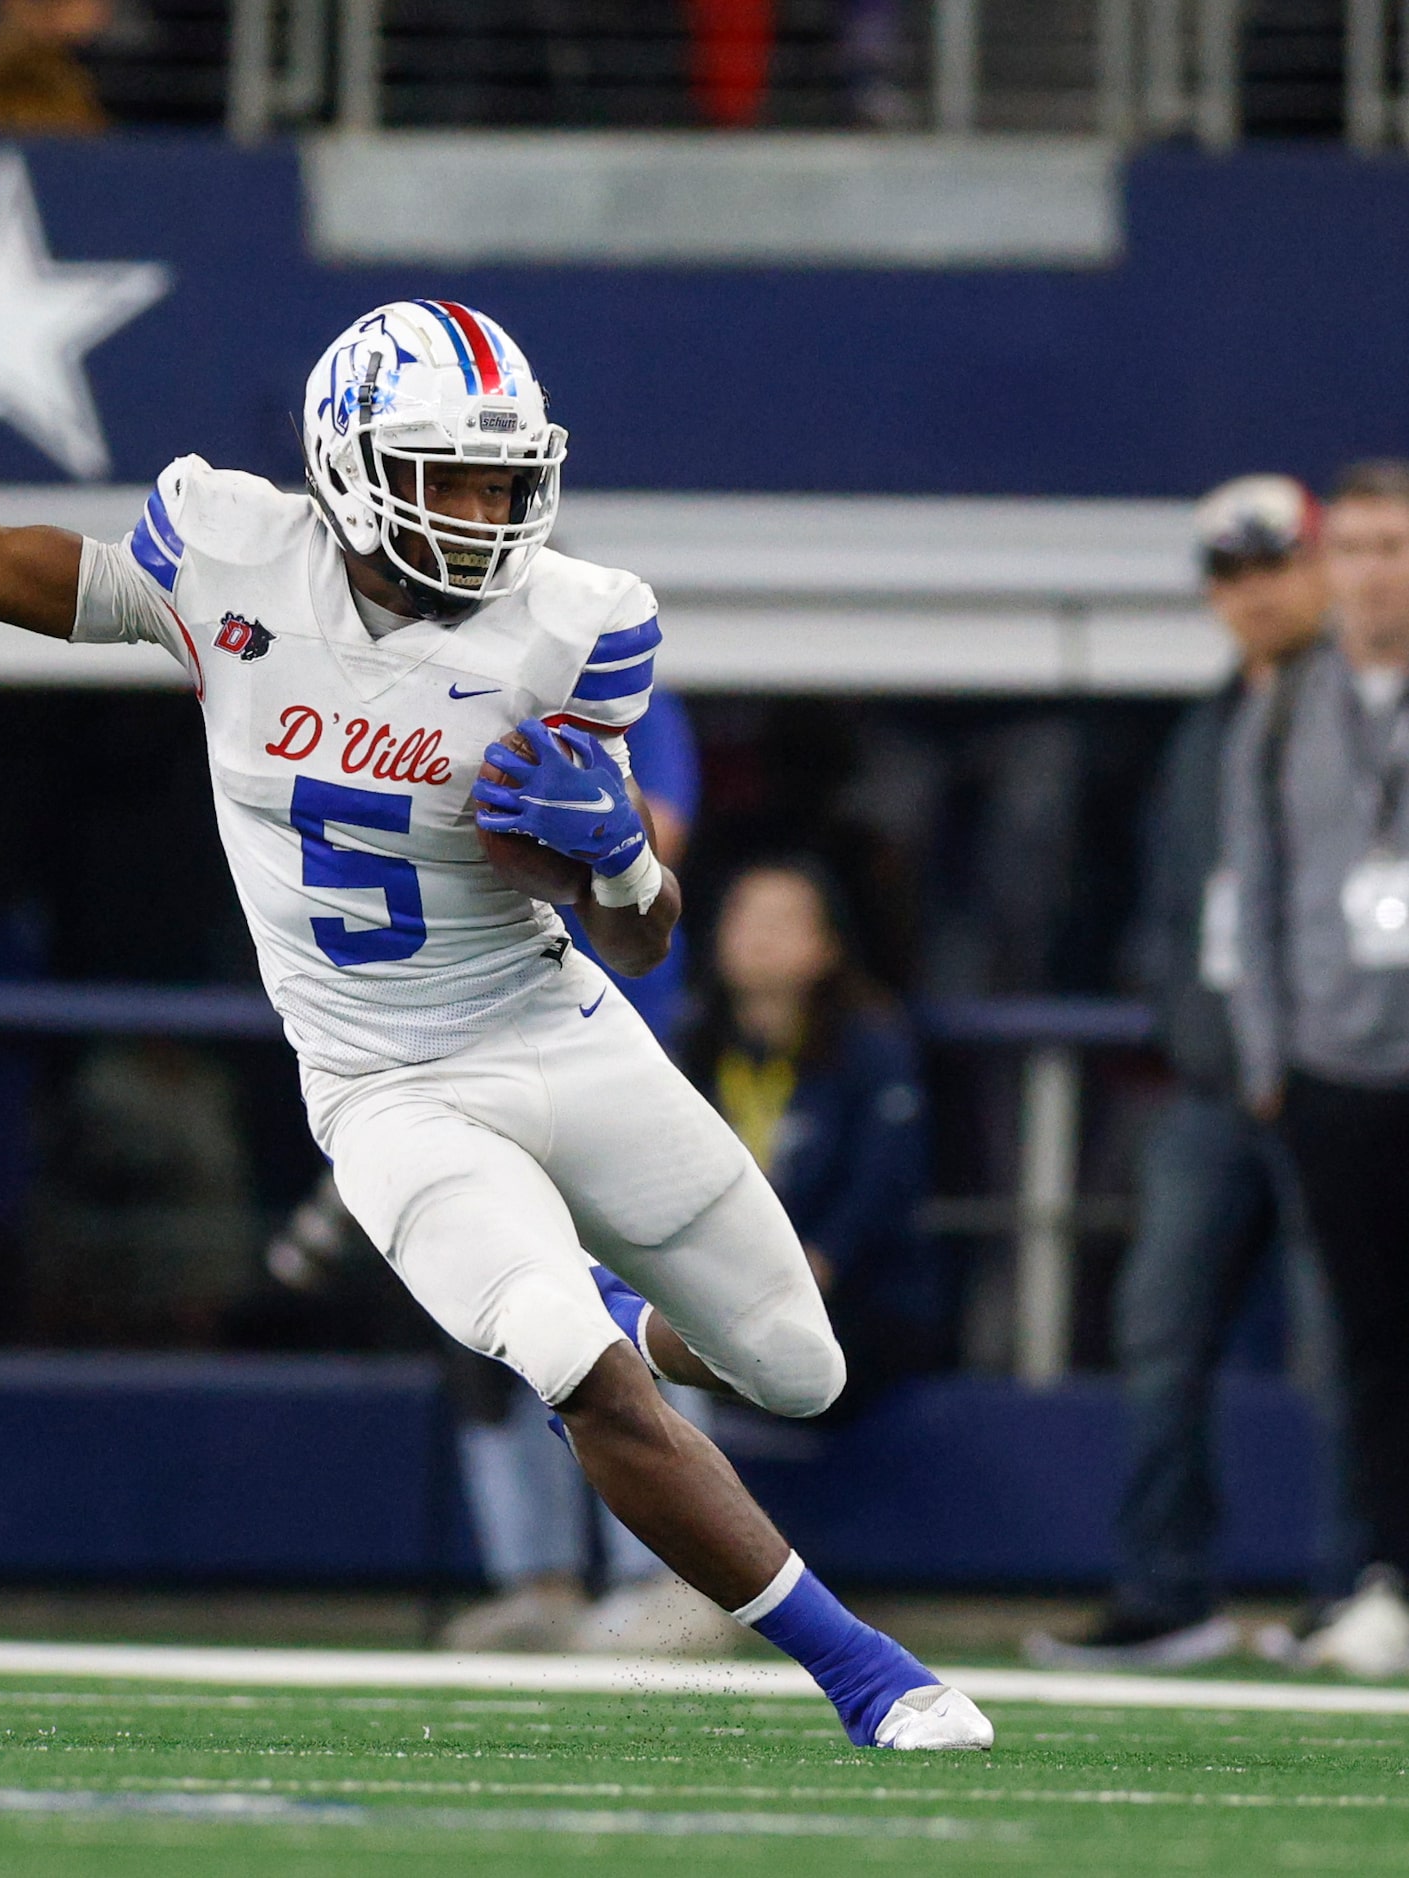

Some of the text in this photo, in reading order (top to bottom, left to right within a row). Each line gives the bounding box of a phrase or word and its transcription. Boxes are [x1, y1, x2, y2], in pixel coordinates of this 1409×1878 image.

[482, 416, 517, 429] schutt
[264, 704, 452, 786] D'Ville
[289, 775, 427, 967] 5
